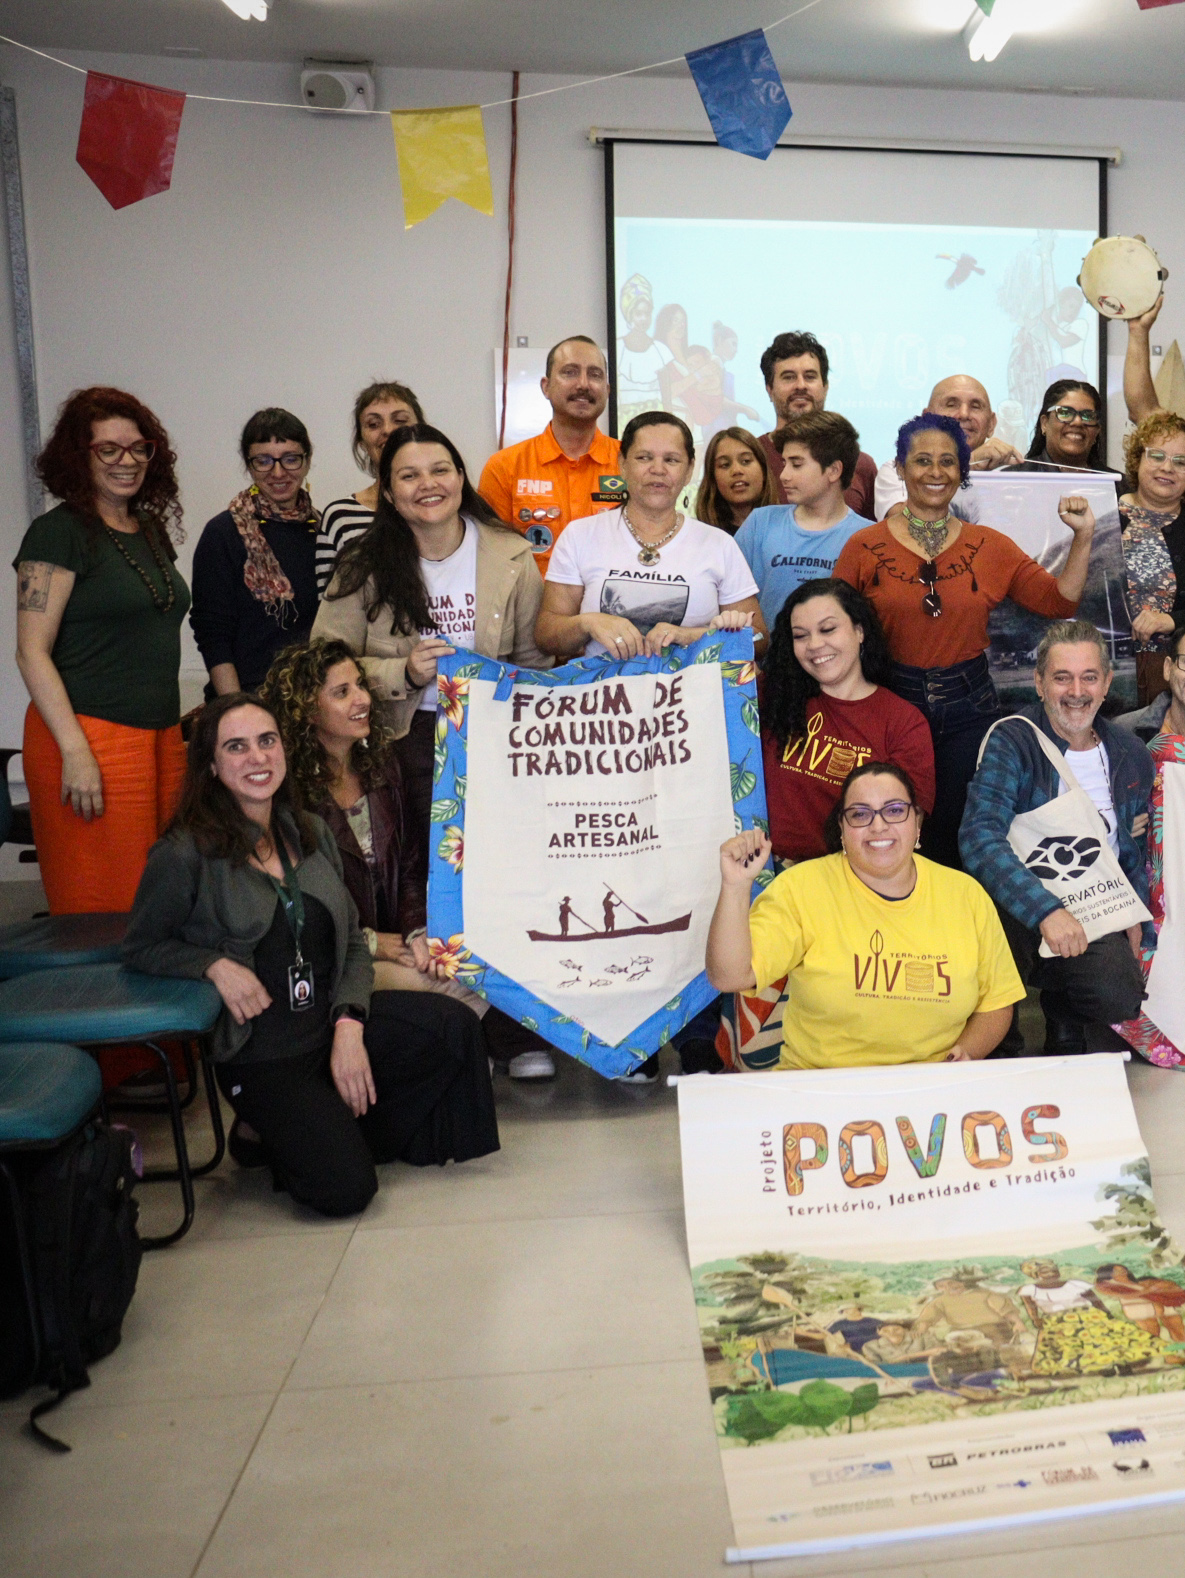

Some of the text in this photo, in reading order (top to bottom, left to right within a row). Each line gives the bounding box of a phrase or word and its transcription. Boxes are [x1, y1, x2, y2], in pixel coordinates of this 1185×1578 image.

[517, 479, 553, 494] FNP
[608, 569, 687, 583] FAMÍLIA
[511, 675, 683, 722] FÓRUM DE
[508, 710, 690, 749] COMUNIDADES
[508, 740, 692, 777] TRADICIONAIS
[548, 826, 660, 848] ARTESANAL
[574, 812, 639, 829] PESCA
[762, 1130, 777, 1193] projeto
[782, 1104, 1069, 1196] POVOS
[889, 1180, 981, 1206] Identidade
[989, 1178, 998, 1188] e
[1005, 1166, 1077, 1187] Tradição
[967, 1441, 1066, 1460] PETROBRAS
